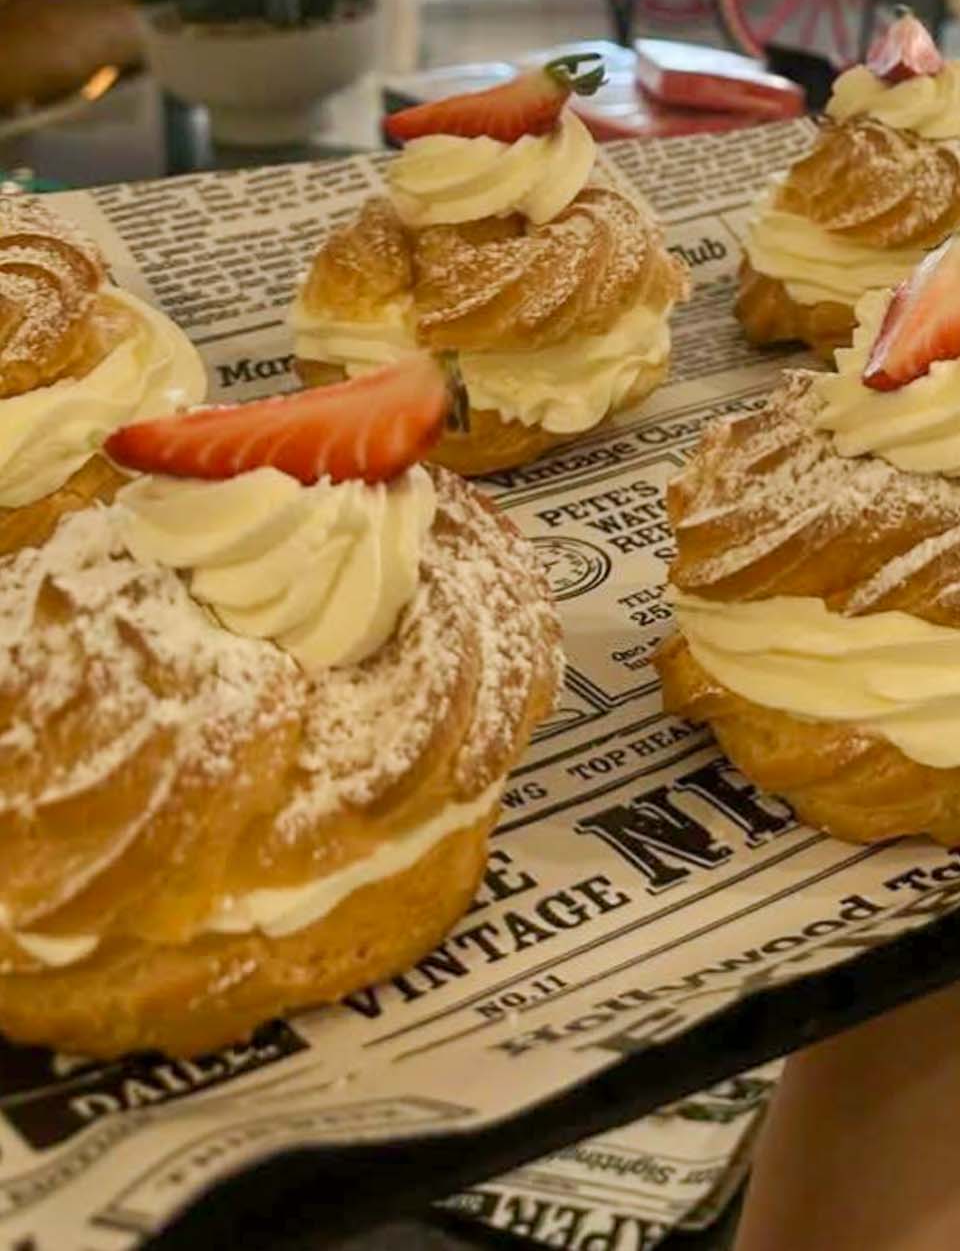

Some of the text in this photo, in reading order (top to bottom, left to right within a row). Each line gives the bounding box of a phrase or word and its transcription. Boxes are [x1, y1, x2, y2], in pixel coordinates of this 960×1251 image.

[485, 441, 632, 490] Vintage
[535, 480, 660, 528] PETE'S
[566, 751, 627, 782] TOP
[341, 876, 632, 1020] VINTAGE
[474, 974, 567, 1021] NO.11
